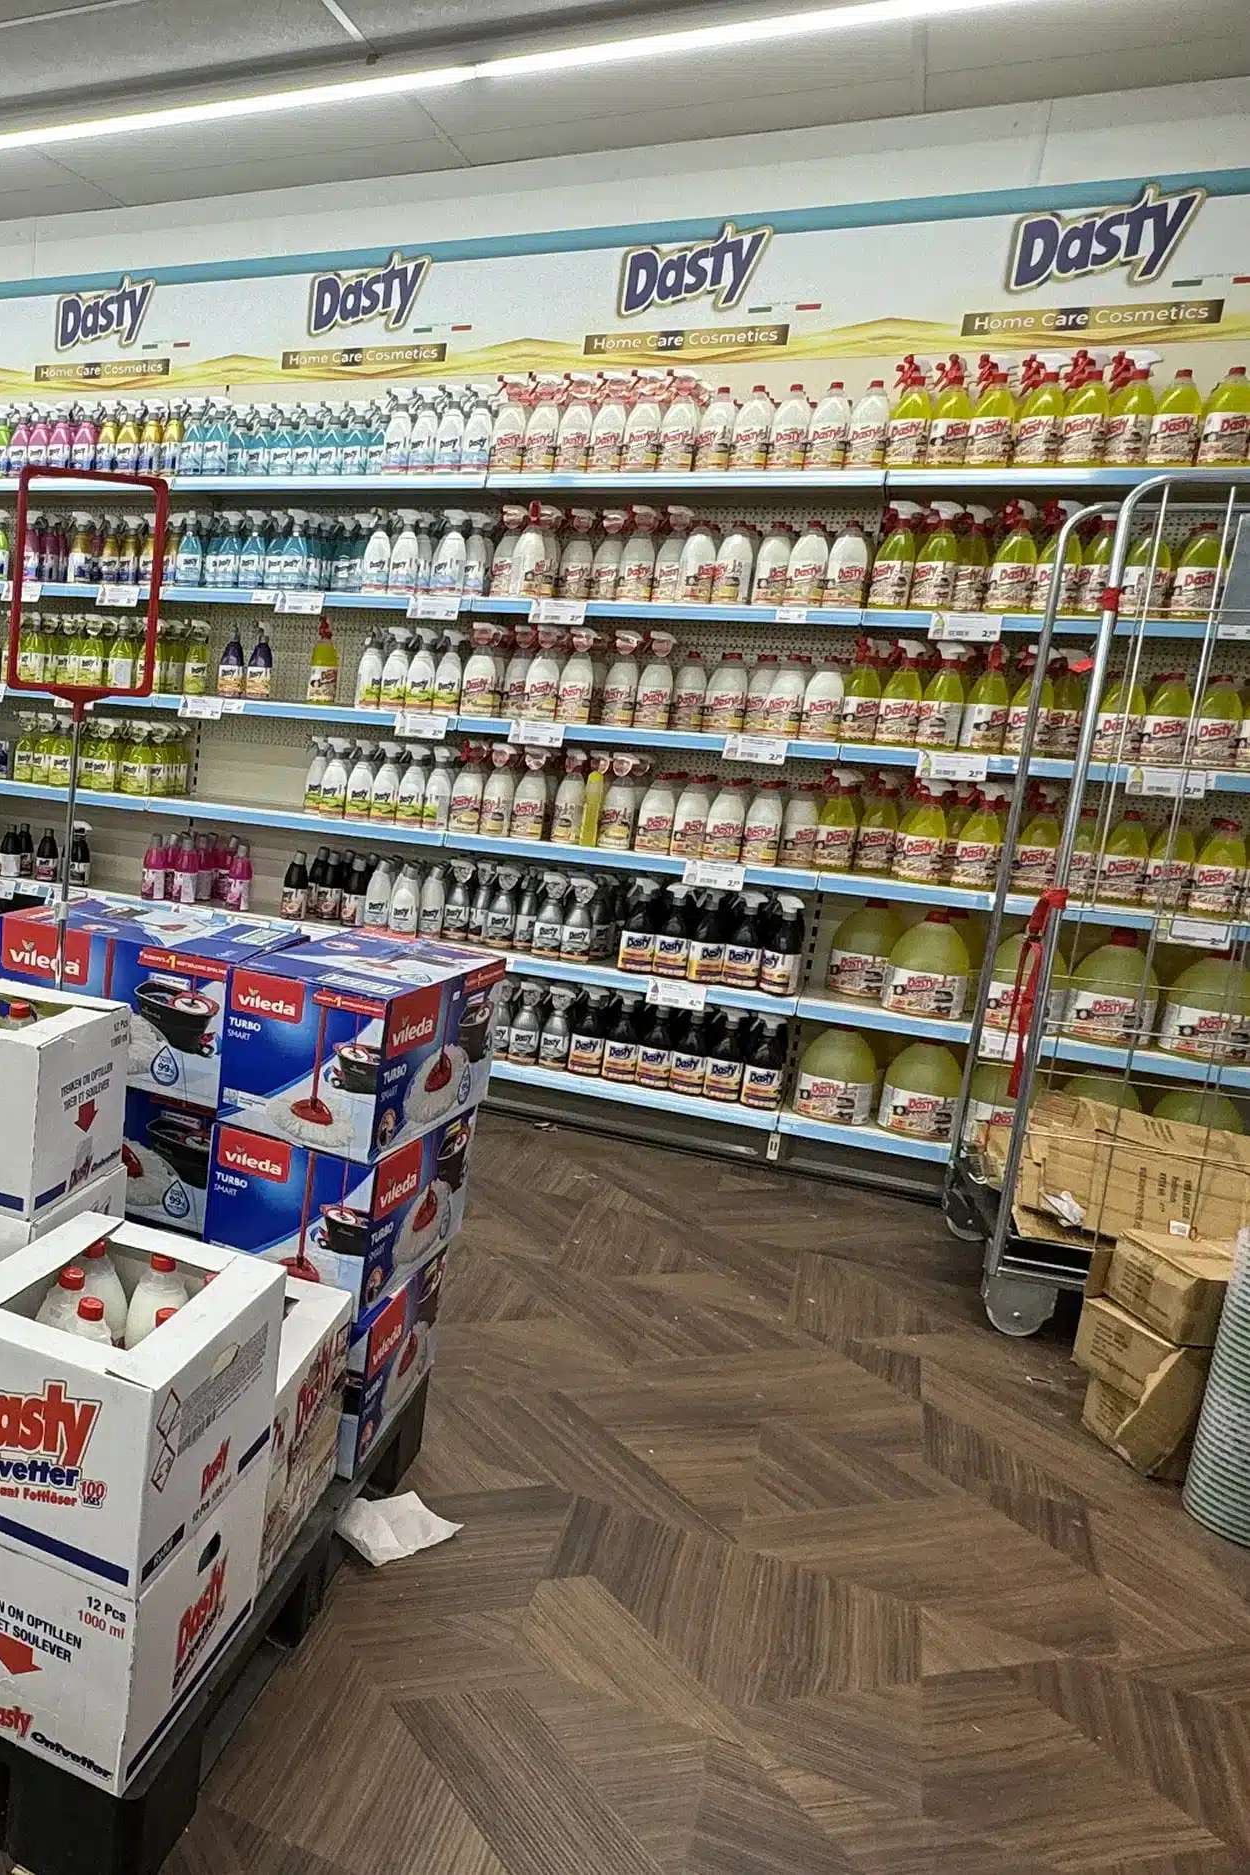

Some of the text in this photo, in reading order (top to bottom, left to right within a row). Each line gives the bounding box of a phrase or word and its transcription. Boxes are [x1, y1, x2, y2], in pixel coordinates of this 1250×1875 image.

[1010, 188, 1201, 290] Dasty
[620, 226, 771, 315] Dasty
[311, 254, 430, 335] Dasty
[58, 280, 154, 350] Dasty
[974, 304, 1209, 331] Home Care Cosmetics
[593, 328, 778, 350] Home Care Cosmetics
[289, 346, 439, 366] Home Care Cosmetics
[40, 361, 164, 378] Home Care Cosmetics
[891, 421, 921, 438] Dasty
[974, 420, 1007, 437] Dasty
[1019, 419, 1049, 437] Dasty
[1063, 417, 1095, 435] Dasty
[1160, 415, 1192, 434] Dasty
[998, 565, 1030, 581] Dasty
[884, 702, 914, 718] Dasty
[1200, 723, 1232, 738] Dasty
[905, 839, 934, 854] Dasty
[959, 845, 990, 861] Dasty
[1019, 850, 1050, 865] Dasty
[1107, 860, 1139, 875] Dasty
[1198, 870, 1231, 886] Dasty
[625, 933, 651, 951] Dasty
[658, 938, 685, 955] Dasty
[727, 947, 755, 965] Dasty
[907, 976, 937, 990] Dasty
[238, 988, 296, 1017] vileda
[1092, 1000, 1128, 1014] Dasty
[229, 1016, 261, 1032] TURBO
[392, 1017, 434, 1047] vileda
[227, 1030, 252, 1041] SMART
[574, 1038, 599, 1054] Dasty
[608, 1045, 634, 1061] Dasty
[641, 1050, 667, 1066] Dasty
[674, 1056, 700, 1071] Dasty
[383, 1063, 407, 1085] TURBO
[711, 1061, 737, 1078] Dasty
[749, 1069, 777, 1086] Dasty
[811, 1082, 839, 1096] Dasty
[907, 1098, 937, 1112] Dasty
[992, 1112, 1015, 1126] Das
[224, 1147, 283, 1178] vileda
[215, 1171, 248, 1189] TURBO
[213, 1183, 238, 1197] SMART
[379, 1171, 418, 1208] vileda
[370, 1220, 395, 1244] TURBO
[371, 1322, 404, 1365] vileda
[200, 1436, 231, 1498] Dasty
[23, 1483, 77, 1506] Fettlöser
[80, 1479, 106, 1498] 100
[86, 1595, 127, 1623] 12 Pcs
[176, 1549, 230, 1668] Dasty
[7, 1602, 24, 1621] ON
[27, 1609, 82, 1650] OPTILLEN
[77, 1609, 125, 1639] 1000 ml
[12, 1622, 72, 1663] SOULEVER
[30, 1732, 113, 1781] Ontvetter
